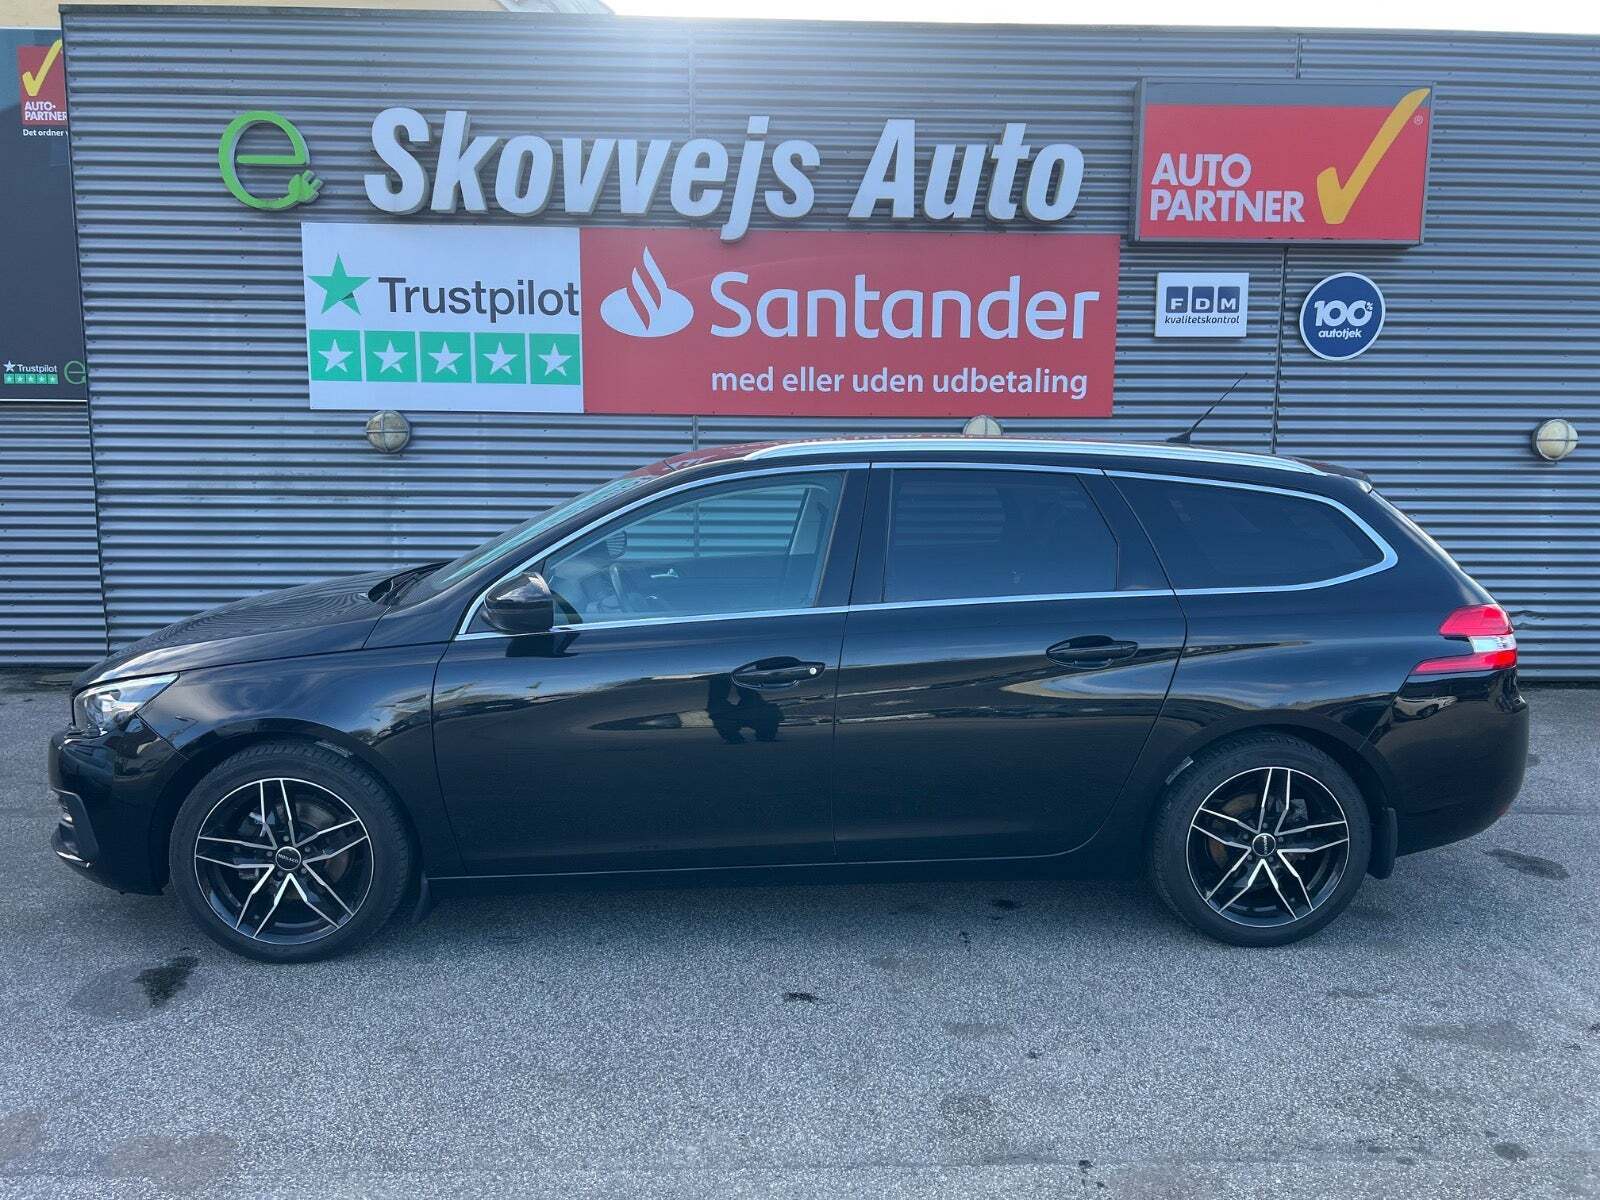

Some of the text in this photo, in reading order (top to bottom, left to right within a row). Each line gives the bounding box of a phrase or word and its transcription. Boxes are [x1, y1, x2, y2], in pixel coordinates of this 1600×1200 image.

[24, 111, 67, 121] PARTNER
[38, 128, 64, 136] ordner
[364, 107, 1086, 243] Skovvejs Auto
[1151, 153, 1252, 187] AUTO
[1149, 189, 1305, 223] PARTNER
[378, 276, 580, 323] Trustpilot
[710, 271, 1100, 340] Santander
[1164, 315, 1240, 326] kvalitetskontrol
[1318, 327, 1363, 340] autotjek
[17, 364, 57, 373] Trustpilot
[711, 366, 1088, 400] med eller uden udbetaling
